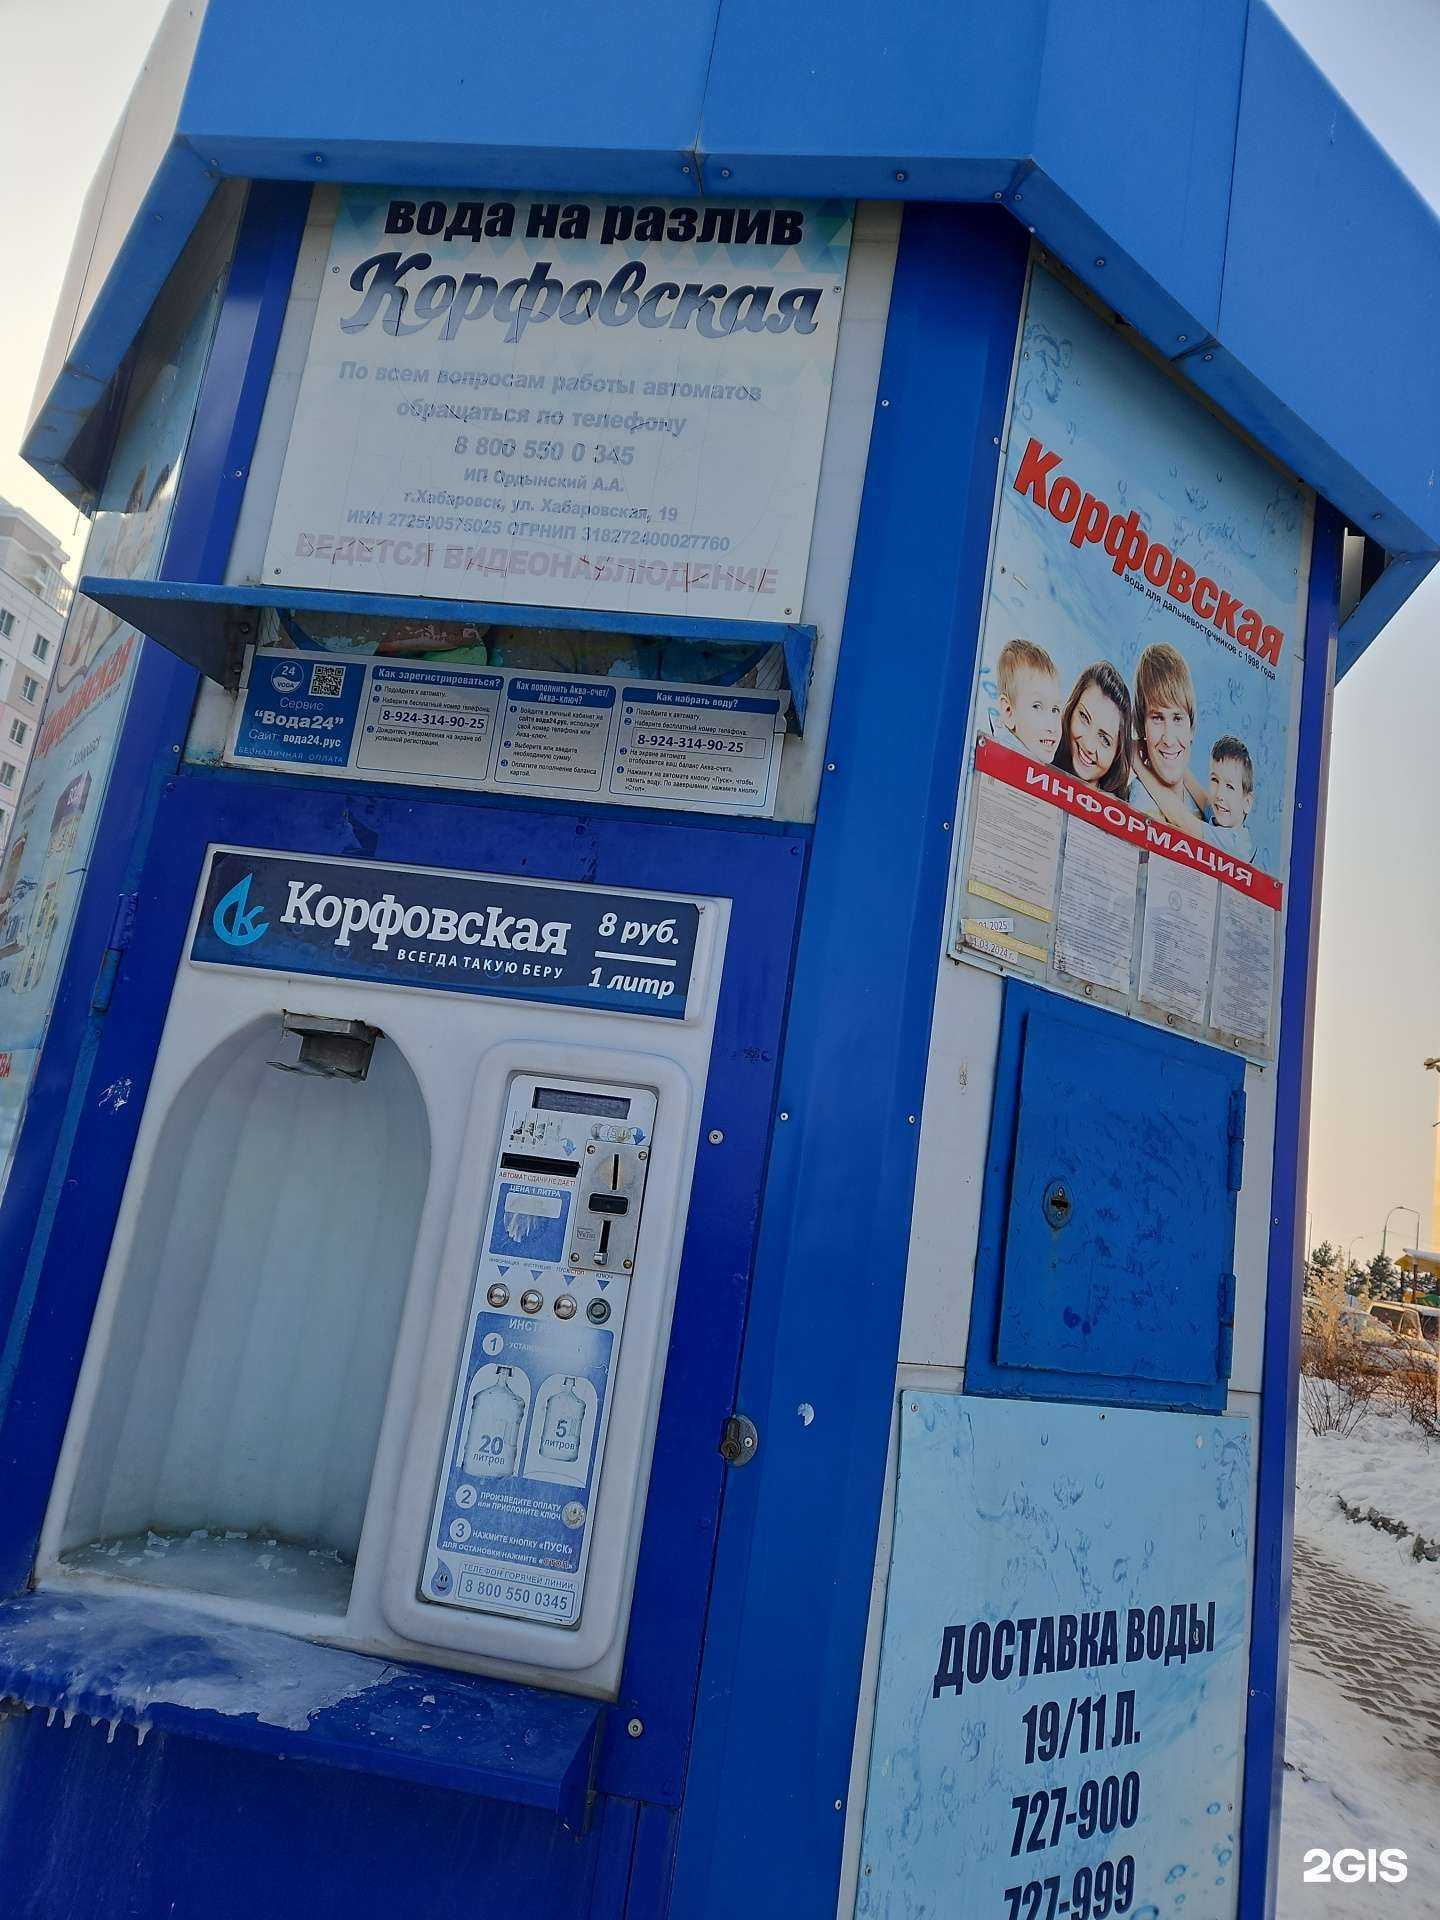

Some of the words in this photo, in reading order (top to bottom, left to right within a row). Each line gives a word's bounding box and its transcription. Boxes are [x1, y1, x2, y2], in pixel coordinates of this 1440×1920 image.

[384, 200, 515, 242] вода
[526, 204, 590, 239] на
[600, 206, 804, 245] разлив
[340, 252, 823, 343] Корфовская
[339, 361, 368, 379] По
[375, 368, 429, 383] всем
[438, 370, 545, 389] вопросам
[552, 374, 635, 394] работы
[643, 382, 761, 401] автоматов
[397, 399, 529, 422] обращаться
[536, 410, 564, 426] по
[572, 412, 687, 437] телефону
[455, 436, 468, 454] 8
[475, 437, 515, 457] 800
[523, 439, 564, 462] 550
[572, 442, 585, 462] 0
[595, 445, 634, 465] 345
[464, 468, 488, 481] ИП
[493, 470, 587, 489] Ордынский
[592, 477, 624, 491] А.А.
[347, 510, 383, 525] ИНН
[508, 523, 575, 540] ОГРНИП
[511, 500, 535, 513] ул.
[659, 506, 677, 521] 19
[295, 532, 435, 567] ВЕДЕТСЯ
[443, 543, 778, 594] ВИДЕОНАБЛЮДЕНИЕ
[1013, 437, 1284, 666] Корфовская
[1125, 574, 1144, 592] вода
[1146, 589, 1161, 604] для
[1163, 599, 1237, 655] дальневосточников
[1239, 650, 1243, 658] с
[1244, 652, 1260, 669] 1998
[1261, 665, 1276, 680] года
[282, 666, 295, 675] 24
[379, 669, 395, 678] Как
[399, 672, 500, 687] зарегистрироваться?
[516, 681, 529, 690] Как
[531, 684, 567, 692] пополнить
[656, 692, 672, 702] Как
[675, 695, 710, 706] набрать
[712, 699, 738, 709] воду?
[280, 697, 323, 711] Сервис
[383, 710, 484, 729] 8-924-314-90-25
[283, 734, 341, 748] вода24.рус
[638, 734, 743, 753] 8-924-314-90-25
[1025, 766, 1254, 887] ИНФОРМАЦИЯ
[279, 881, 572, 956] Корфовская
[598, 912, 615, 937] 8
[621, 916, 680, 946] руб.
[398, 947, 459, 969] ВСЕГДА
[464, 955, 517, 974] ТАКУЮ
[523, 962, 563, 978] БЕРУ
[589, 968, 603, 989] 1
[608, 972, 675, 999] литр
[509, 1184, 530, 1193] ЦЕНА
[537, 1188, 560, 1197] ЛИТРА
[556, 1420, 567, 1437] 5
[473, 1453, 505, 1466] литров
[479, 1435, 503, 1455] 20
[544, 1439, 575, 1450] литров
[473, 1530, 508, 1542] НАЖМИТЕ
[465, 1580, 473, 1592] 8
[478, 1581, 501, 1598] 800
[506, 1587, 530, 1603] 550
[535, 1592, 567, 1610] 0345
[932, 1610, 1118, 1698] ДОСТАВКА
[1126, 1602, 1216, 1667] ВОДЫ
[1022, 1691, 1105, 1765] 19/11
[1111, 1690, 1141, 1748] Л.
[1010, 1771, 1140, 1857] 727-900
[1003, 1855, 1135, 1920] 727-999
